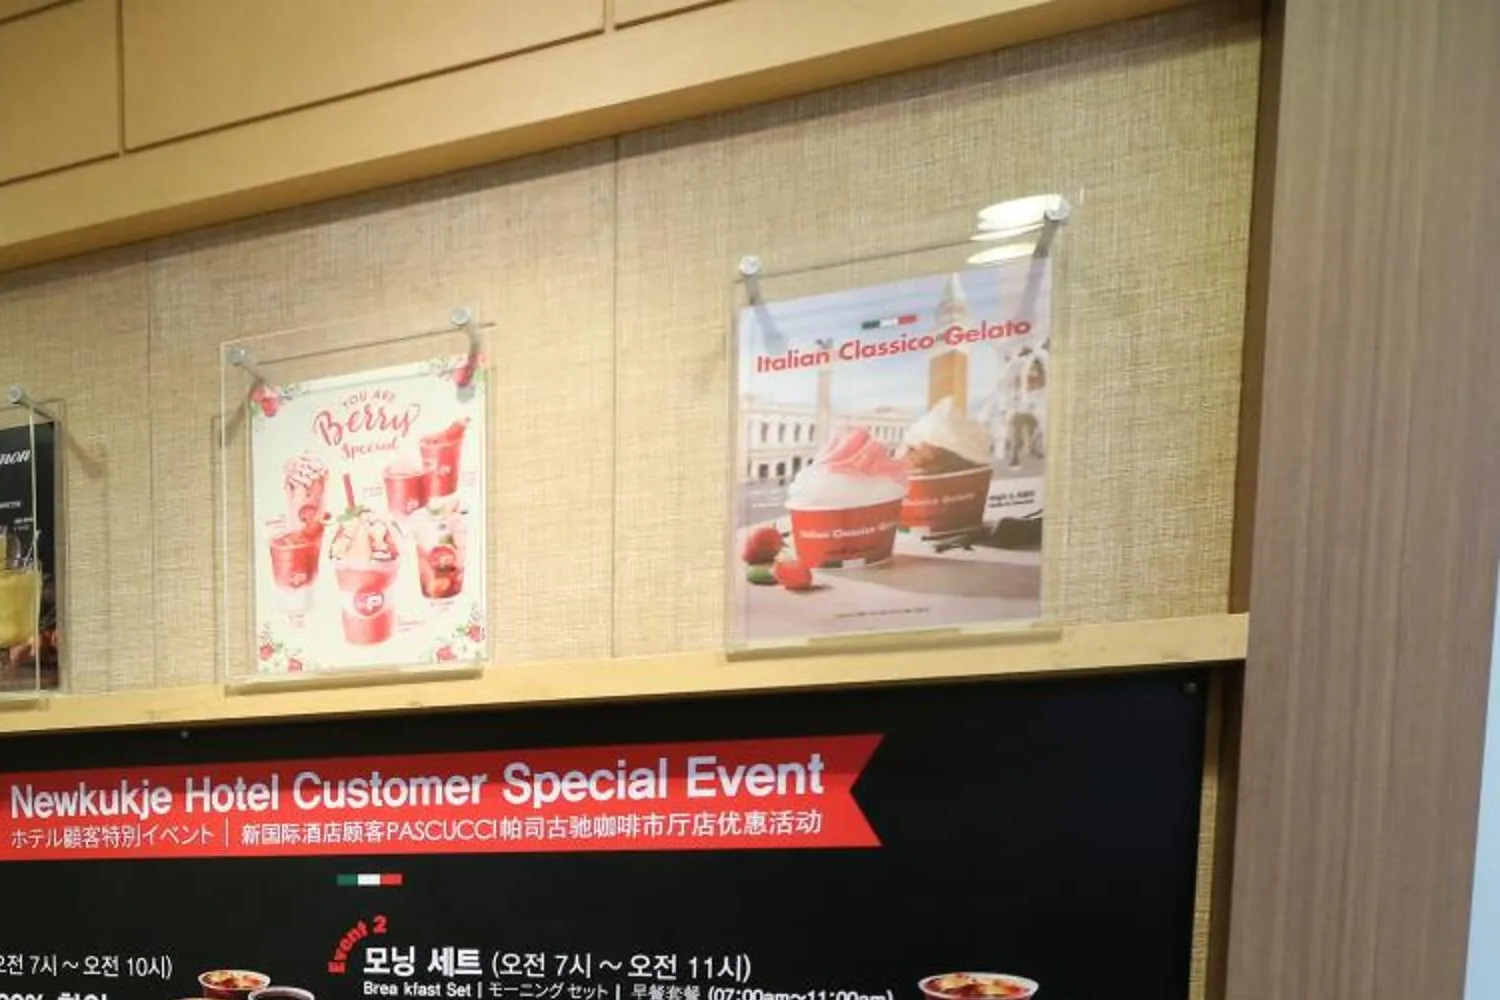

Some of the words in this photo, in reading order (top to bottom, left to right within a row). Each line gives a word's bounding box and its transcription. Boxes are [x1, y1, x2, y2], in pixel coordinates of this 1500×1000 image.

[756, 350, 830, 374] Italian
[838, 333, 938, 362] Classico
[943, 318, 1032, 346] Gelato
[311, 402, 421, 447] Berry
[10, 779, 174, 821] Newkukje
[184, 772, 280, 814] Hotel
[292, 769, 488, 811] Customer
[502, 757, 669, 808] Special
[686, 752, 825, 798] Event
[30, 954, 58, 977] 7시
[83, 955, 119, 978] 오전
[127, 954, 174, 980] 10시)
[327, 919, 370, 975] Event
[372, 914, 388, 934] 2
[363, 945, 416, 977] 모닝
[427, 945, 484, 977] 세트
[491, 951, 546, 979] (오전
[555, 951, 592, 979] 7시
[627, 954, 678, 981] 오전
[688, 953, 752, 983] 11시)
[446, 983, 472, 998] Set
